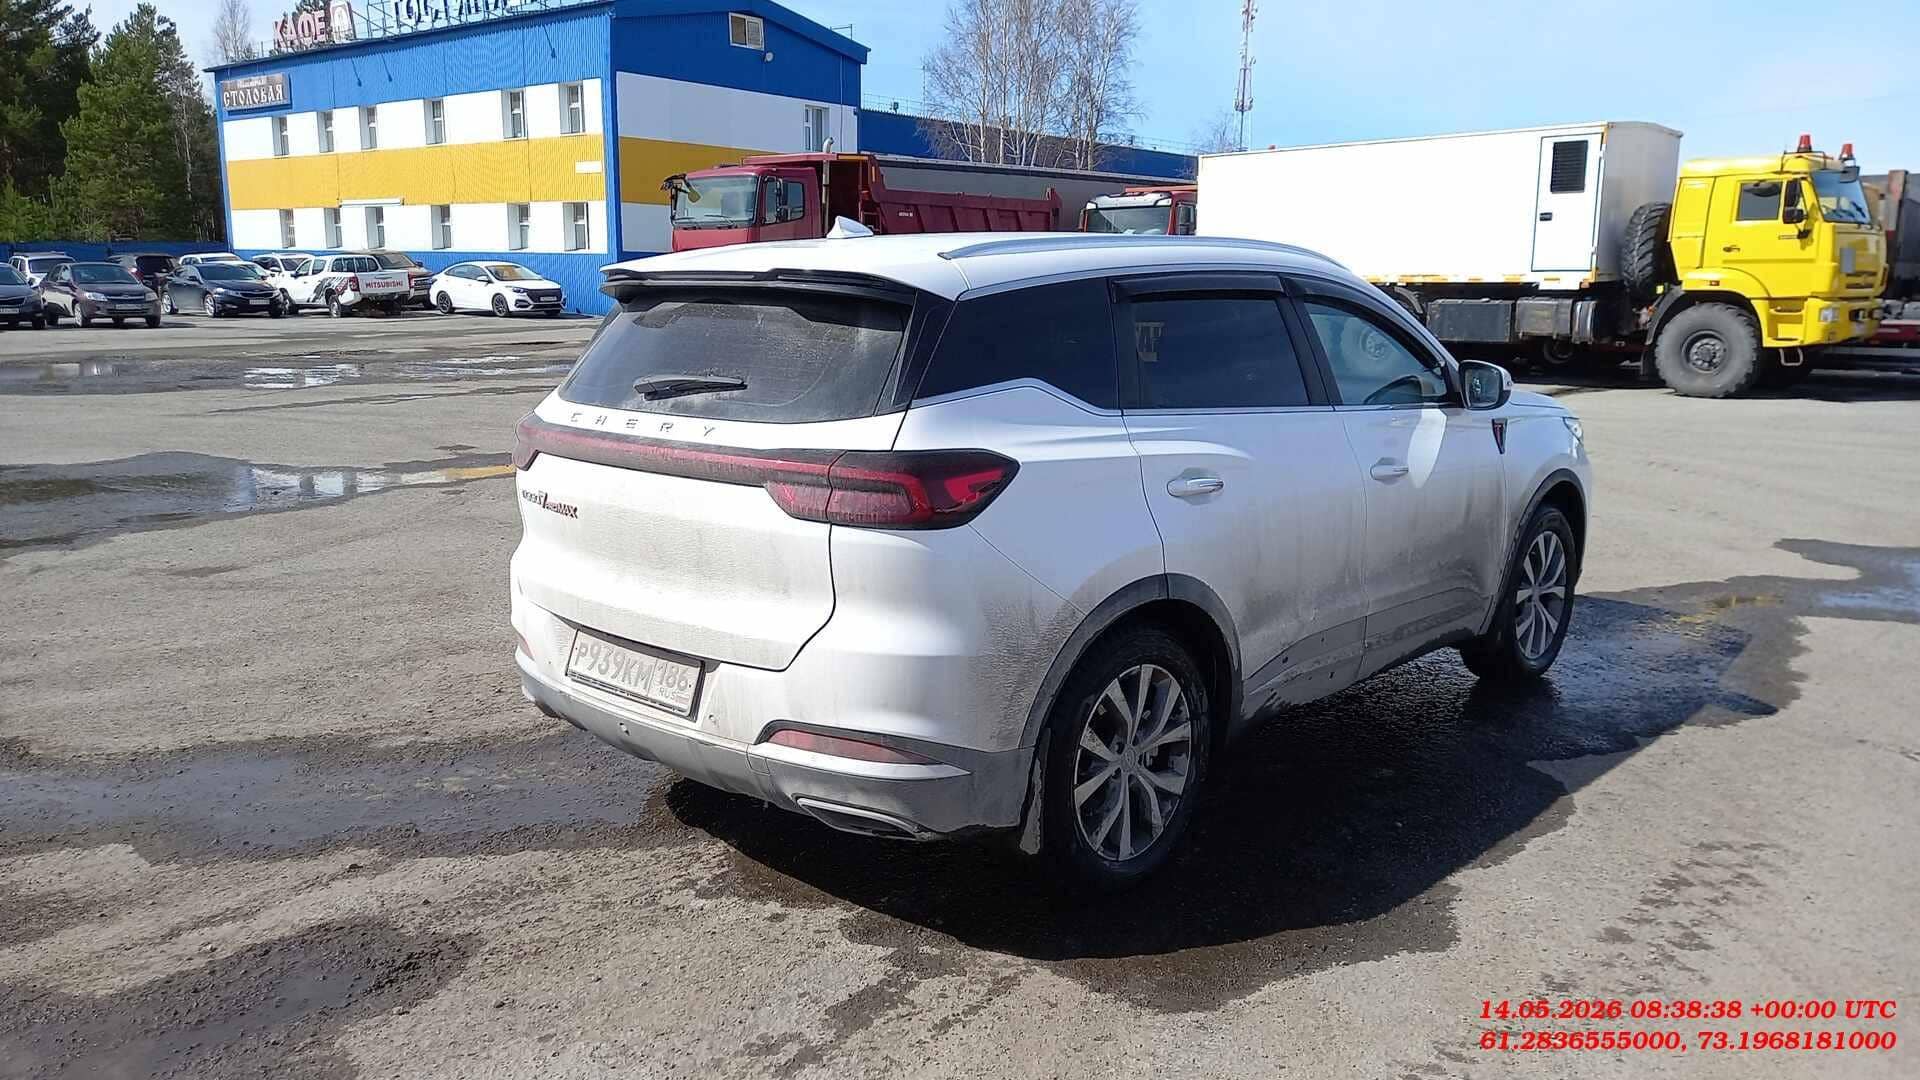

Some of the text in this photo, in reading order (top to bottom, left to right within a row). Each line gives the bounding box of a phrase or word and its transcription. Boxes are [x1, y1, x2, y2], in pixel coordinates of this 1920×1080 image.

[273, 10, 326, 48] КАФЕ
[223, 84, 283, 107] СТОЛОВАЯ
[365, 280, 403, 288] MITSUBISHI
[570, 412, 716, 437] CHERY
[657, 662, 690, 692] 186
